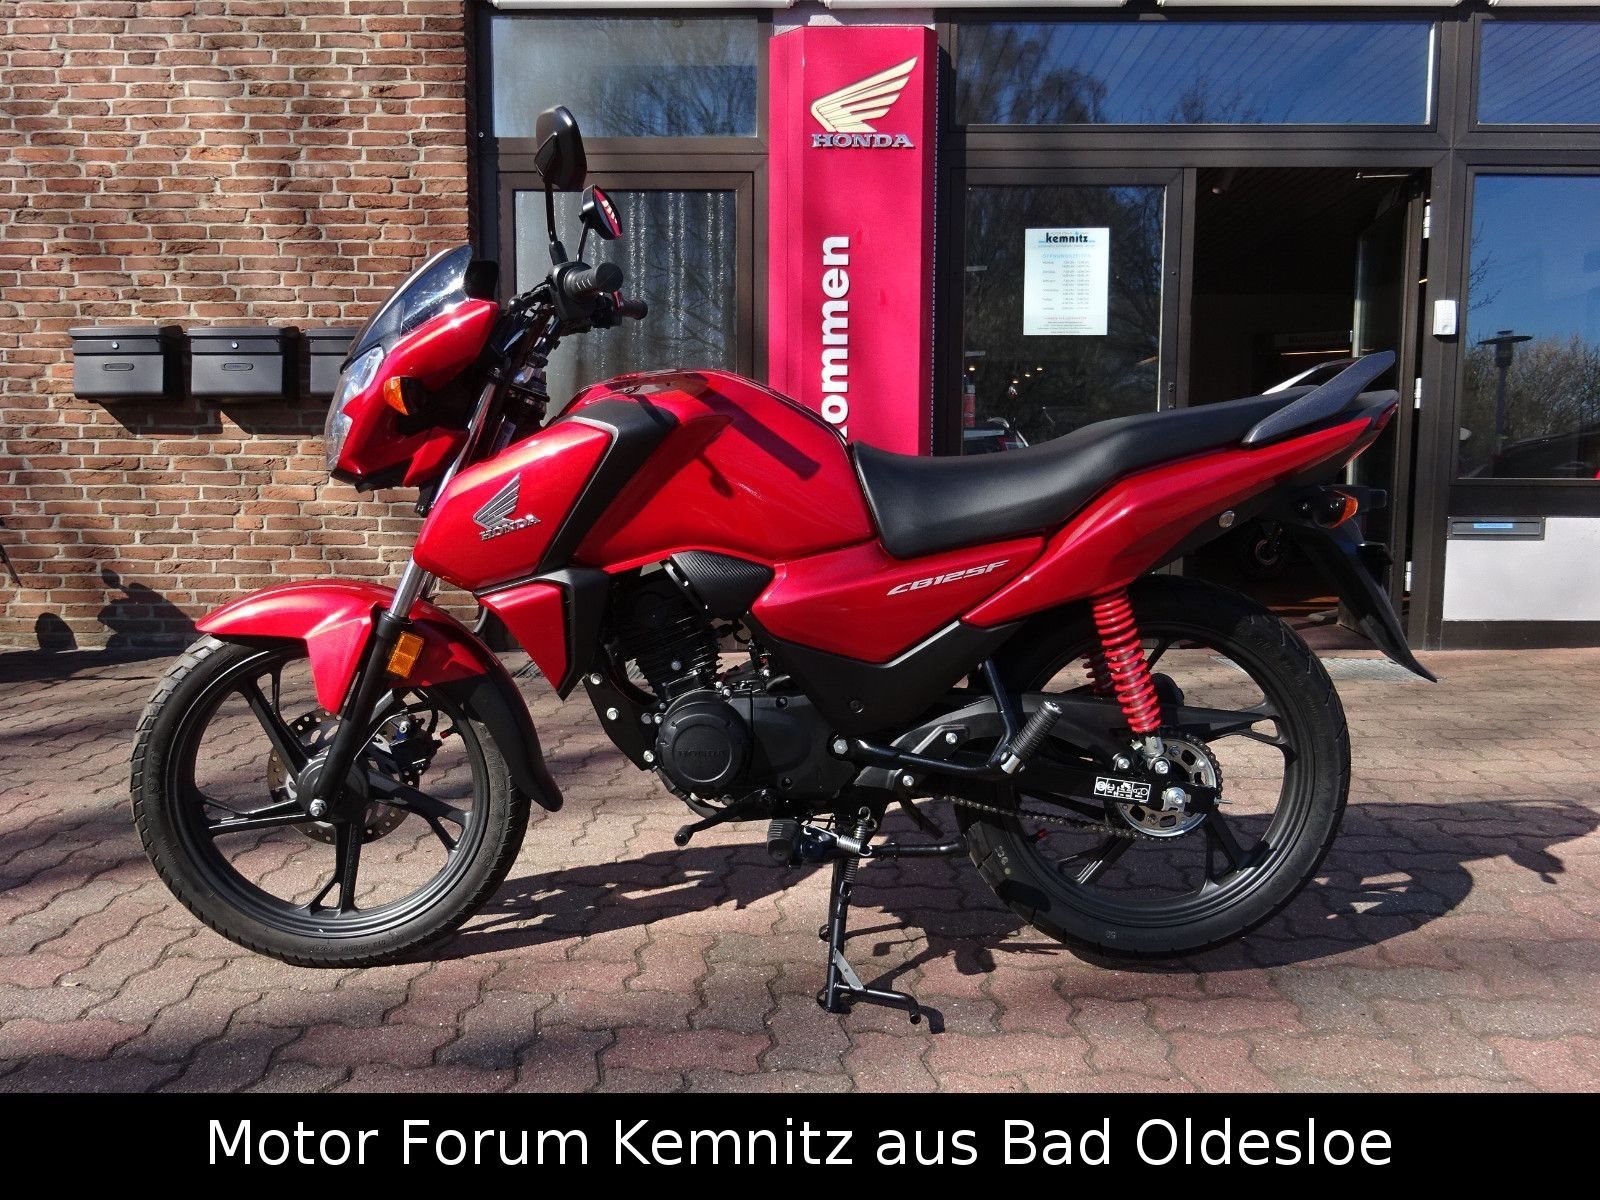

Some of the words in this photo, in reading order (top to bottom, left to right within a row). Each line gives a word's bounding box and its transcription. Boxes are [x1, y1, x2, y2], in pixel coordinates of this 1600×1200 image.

[810, 133, 915, 148] HONDA
[1046, 232, 1088, 243] kemnitz
[821, 236, 850, 437] ommen
[479, 514, 541, 540] HONDA
[886, 559, 1010, 596] CB125F
